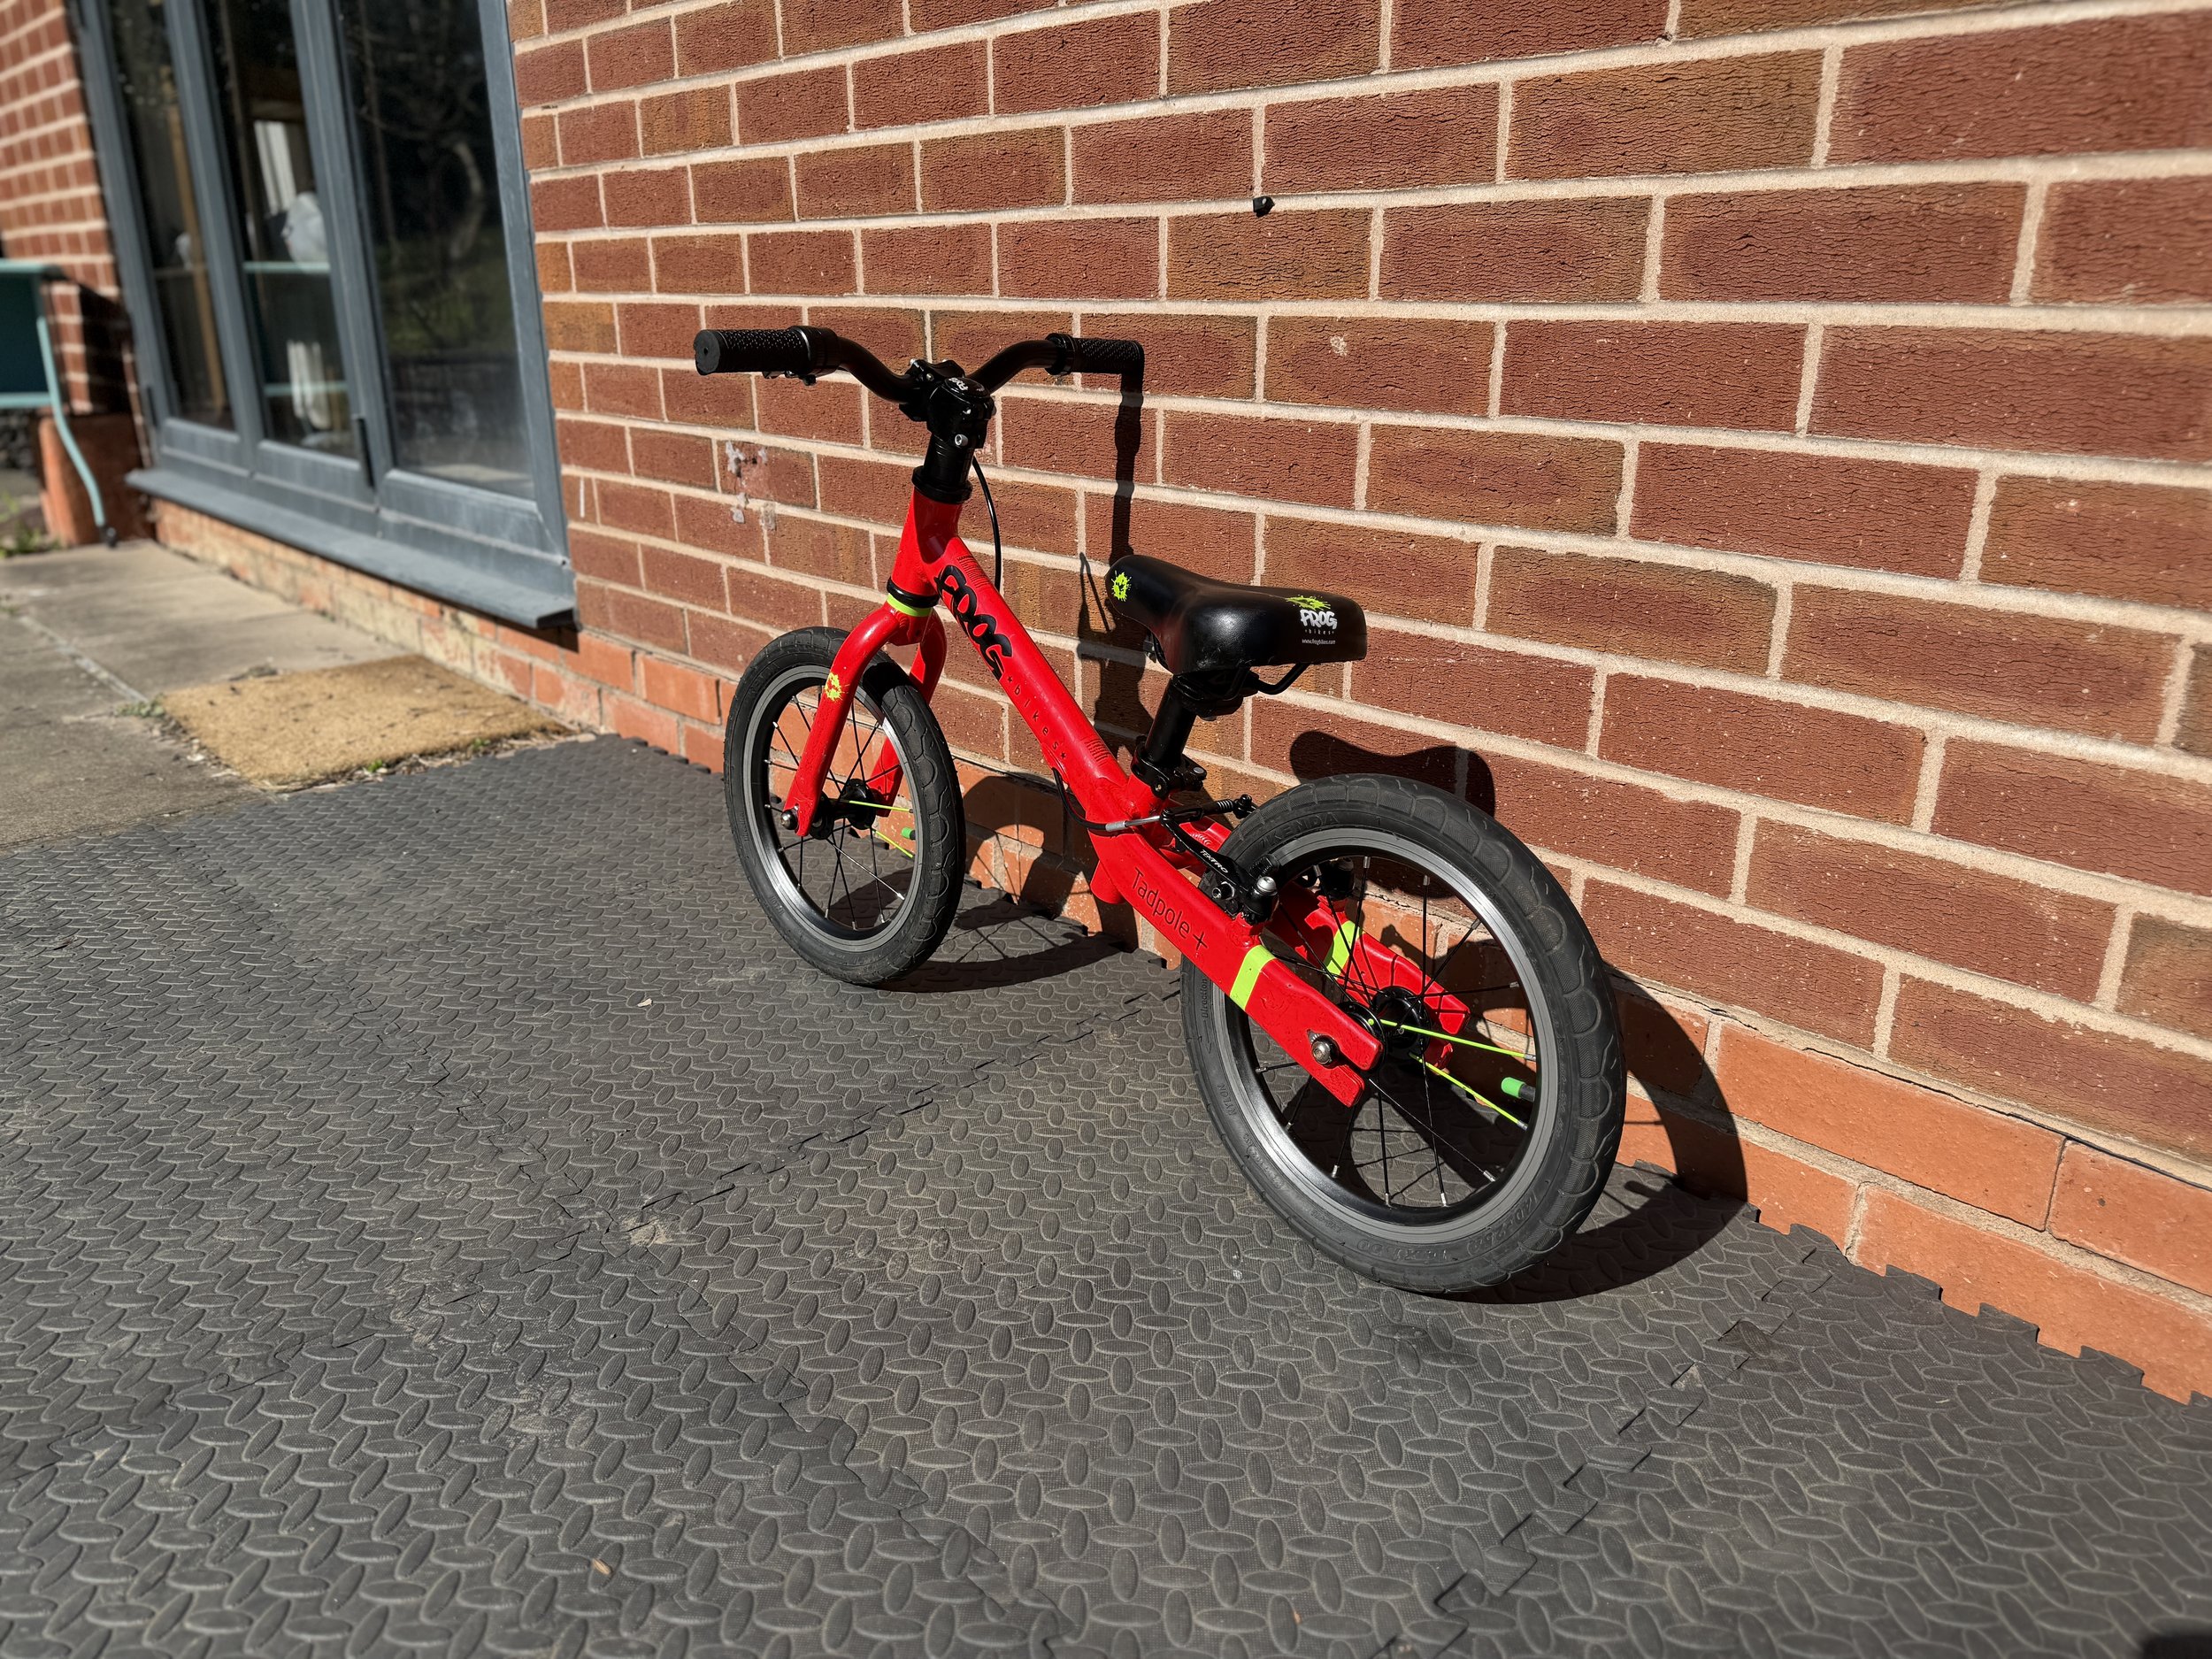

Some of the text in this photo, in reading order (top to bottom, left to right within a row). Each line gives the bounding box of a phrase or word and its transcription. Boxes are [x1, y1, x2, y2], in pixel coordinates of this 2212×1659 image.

[933, 565, 1012, 680] FROG
[1300, 609, 1338, 629] FROG
[1013, 685, 1059, 752] bikes
[1200, 849, 1228, 873] TEKTRO
